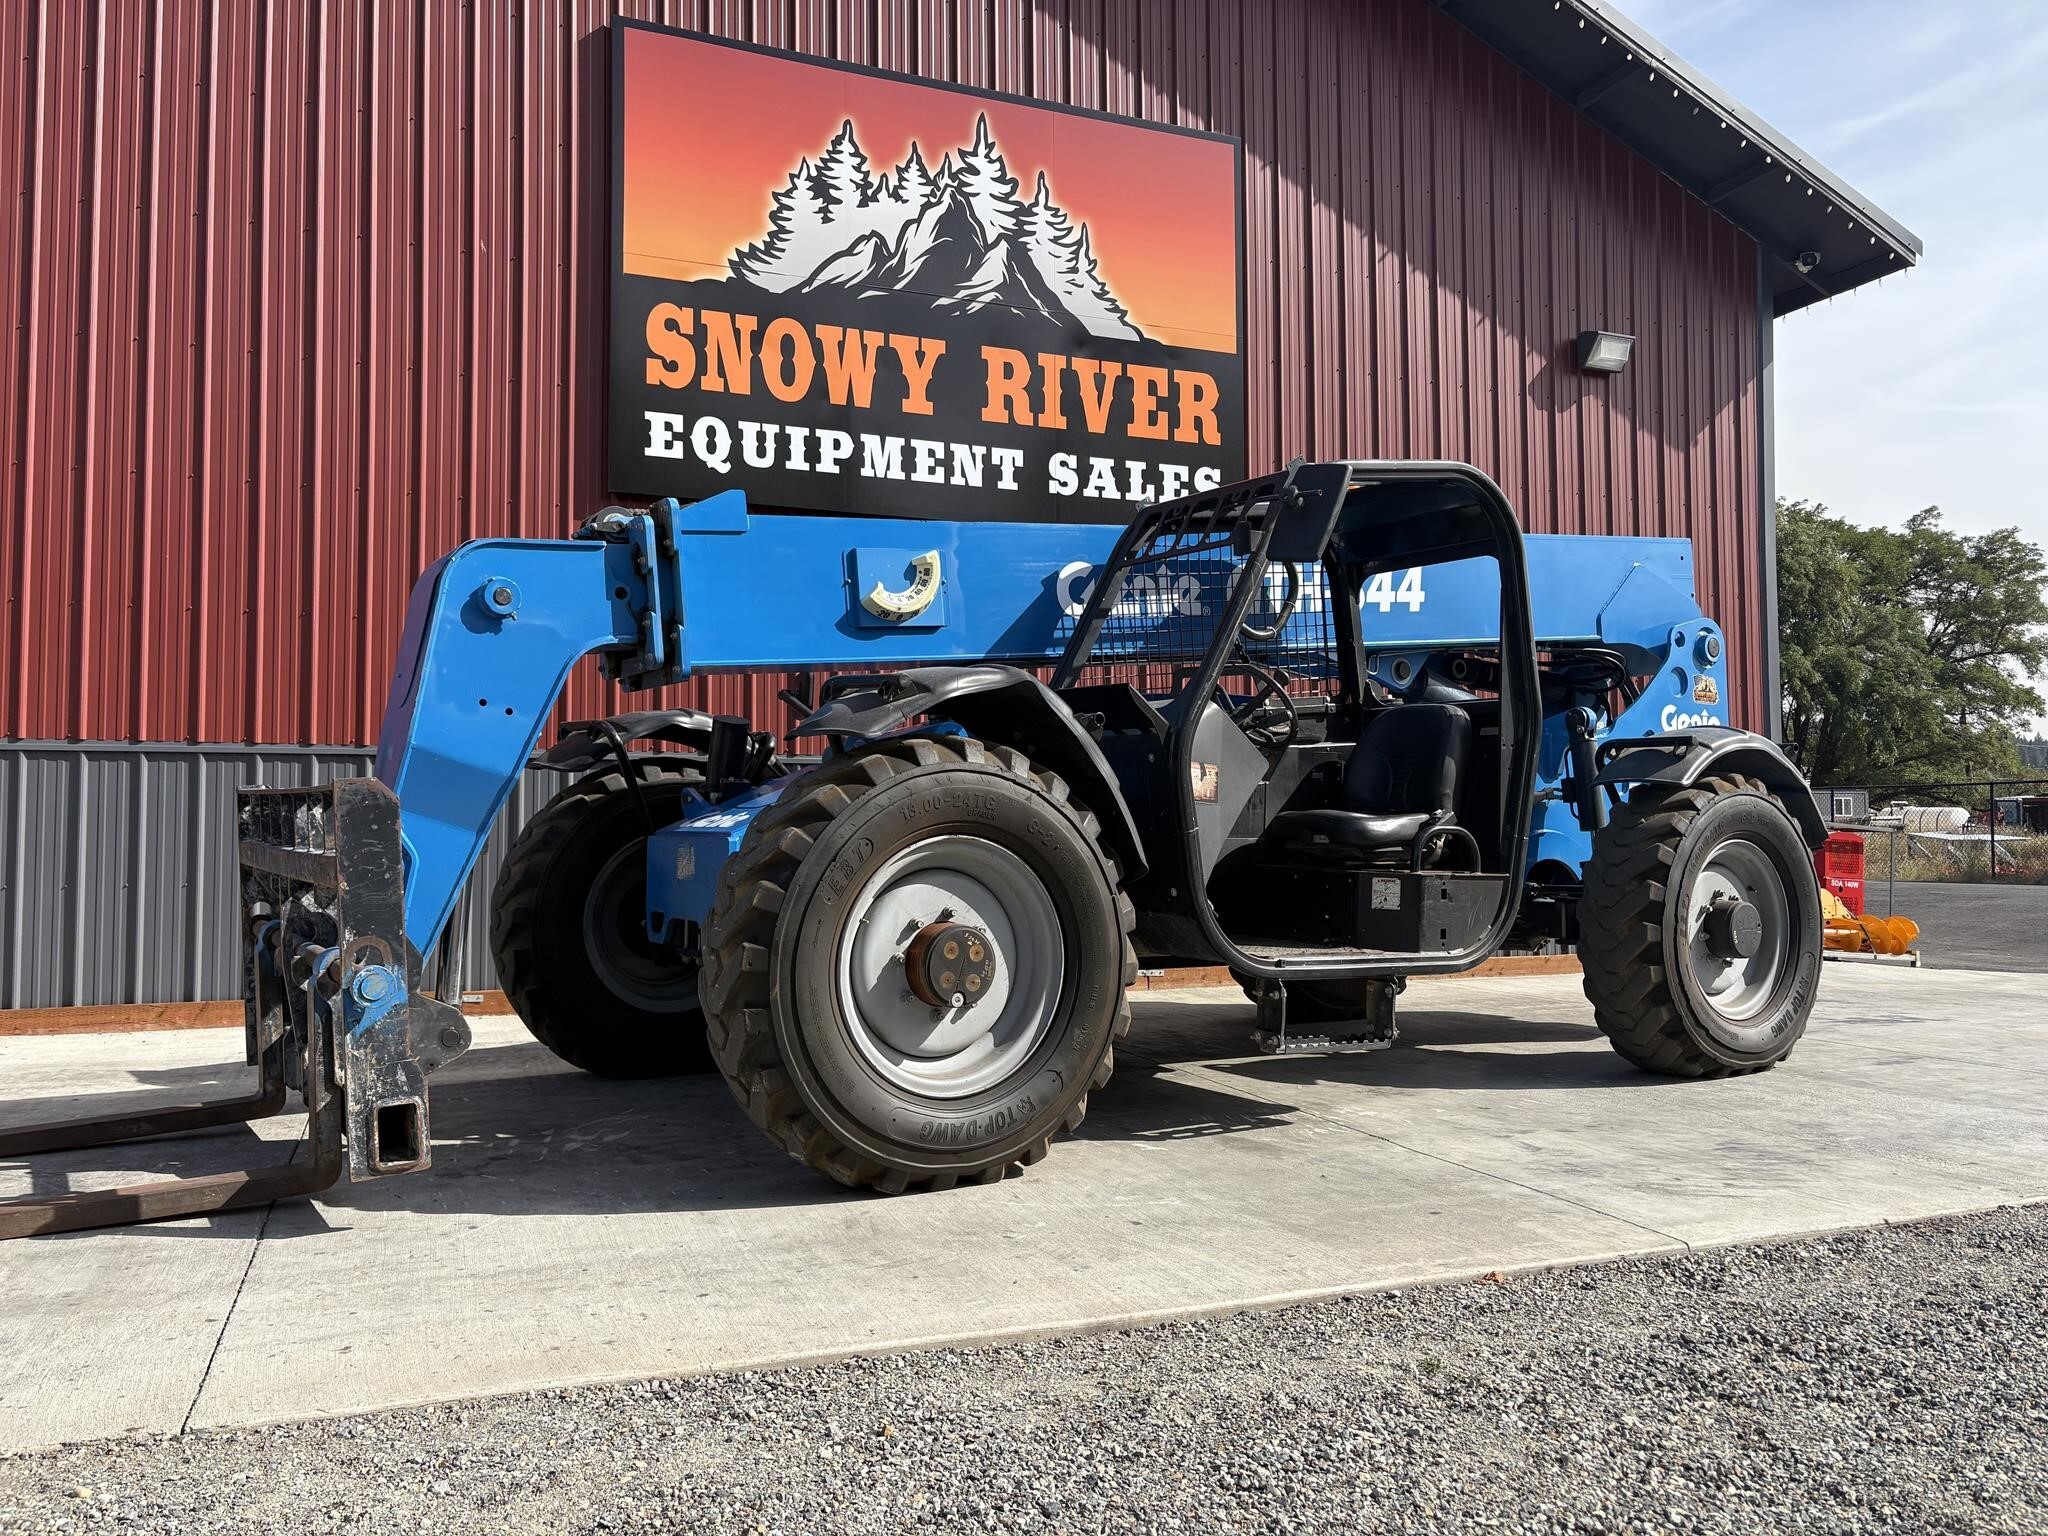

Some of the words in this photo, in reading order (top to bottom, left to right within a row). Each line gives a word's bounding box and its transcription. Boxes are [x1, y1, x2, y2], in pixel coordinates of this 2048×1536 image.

[646, 303, 944, 415] SNOWY
[982, 346, 1221, 445] RIVER
[645, 411, 1023, 490] EQUIPMENT
[1049, 453, 1220, 502] SALES
[1226, 562, 1426, 613] TH-44
[919, 1120, 979, 1144] DAWG
[984, 1106, 1018, 1137] TOP
